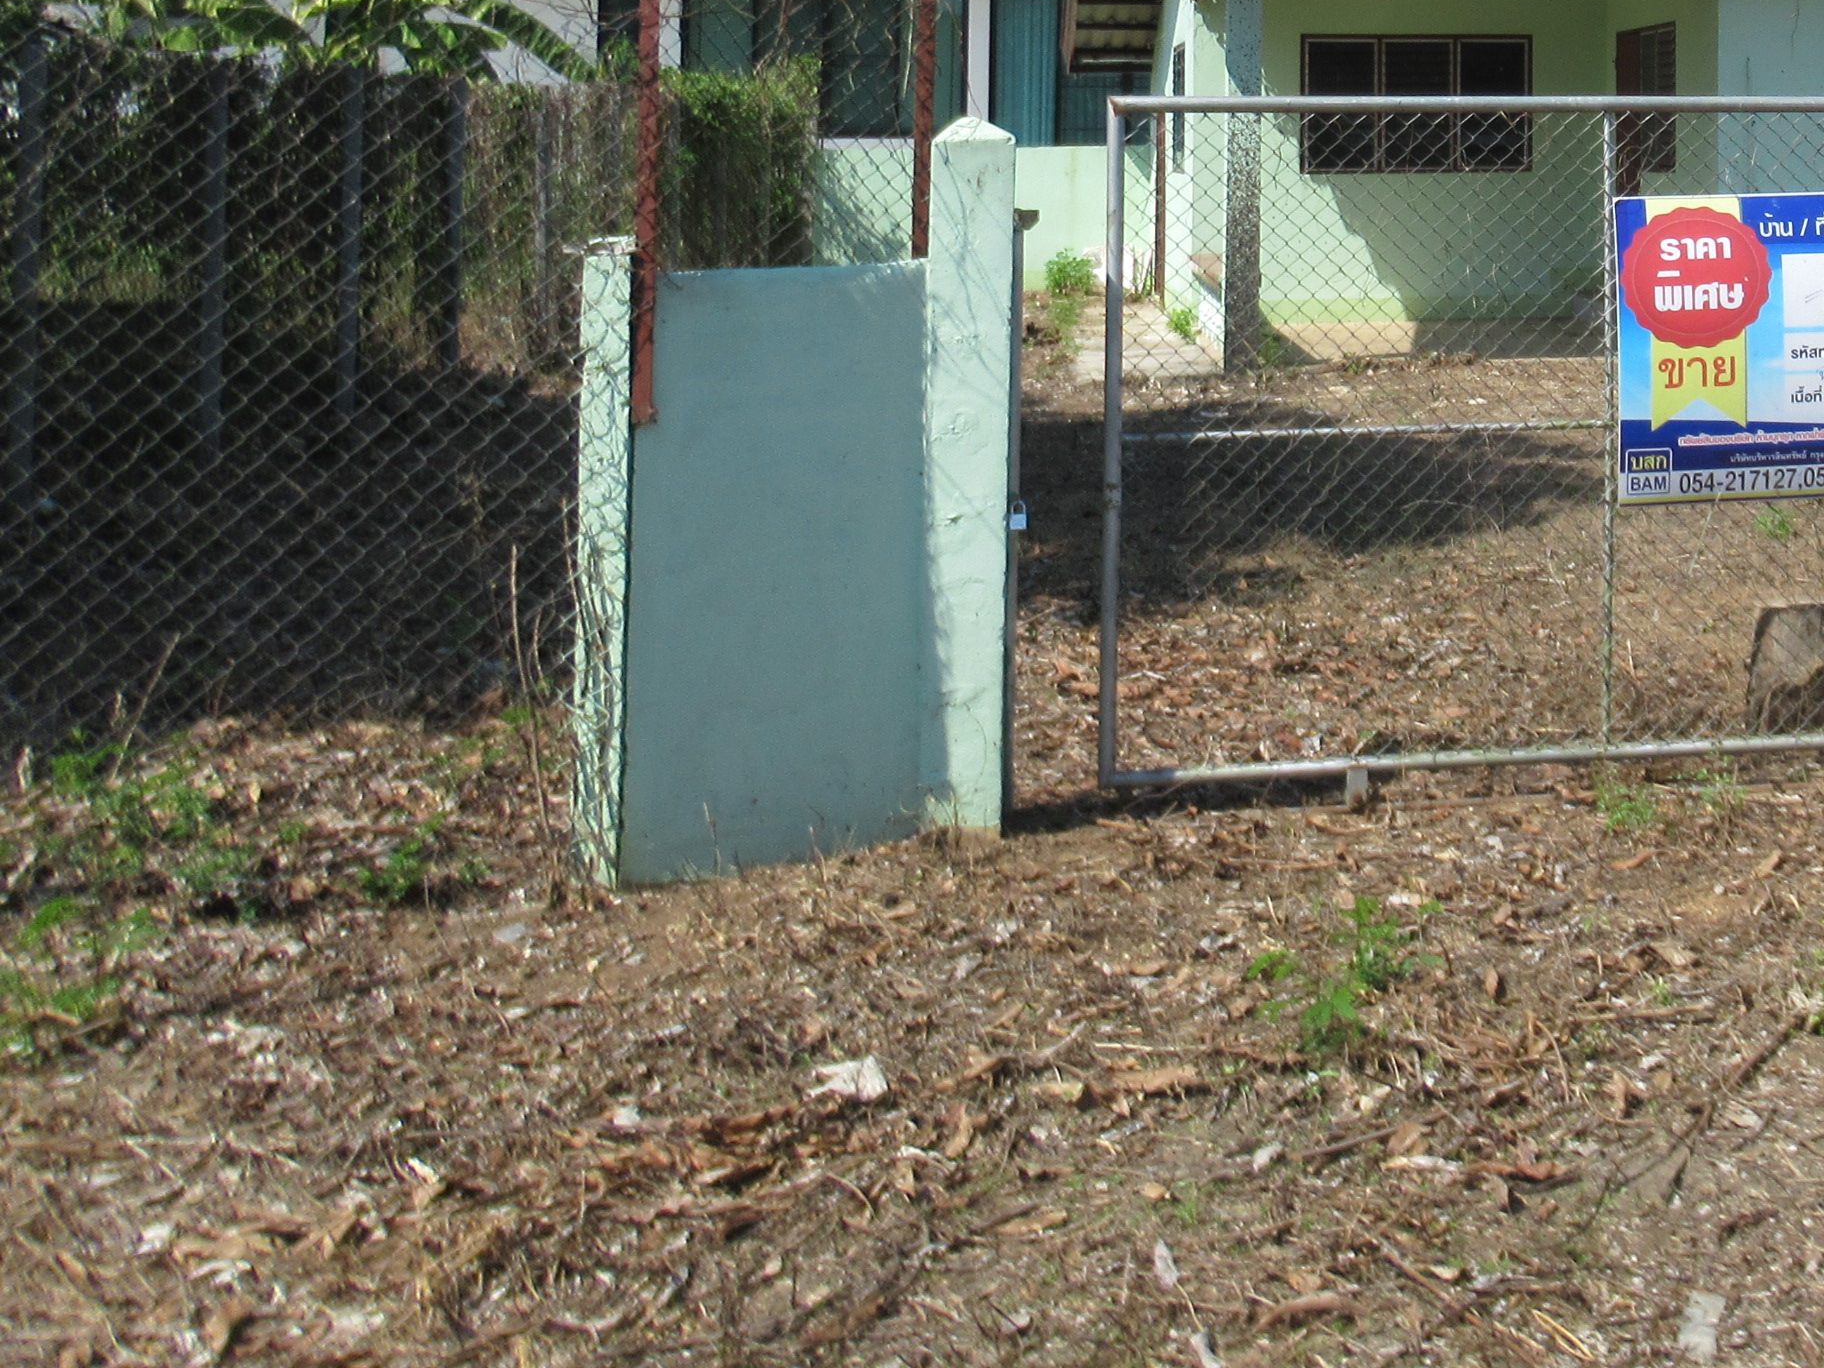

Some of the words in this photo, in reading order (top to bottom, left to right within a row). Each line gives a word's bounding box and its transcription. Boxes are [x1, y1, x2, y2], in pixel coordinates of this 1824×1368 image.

[1760, 213, 1793, 237] บ้าน
[1800, 218, 1808, 236] /
[1660, 236, 1732, 261] ราคา
[1654, 270, 1745, 312] พิเศษ
[1658, 356, 1736, 389] ขาย
[1791, 385, 1822, 403] เนื้อที่
[1631, 454, 1667, 471] บสก
[1631, 476, 1667, 491] BAM
